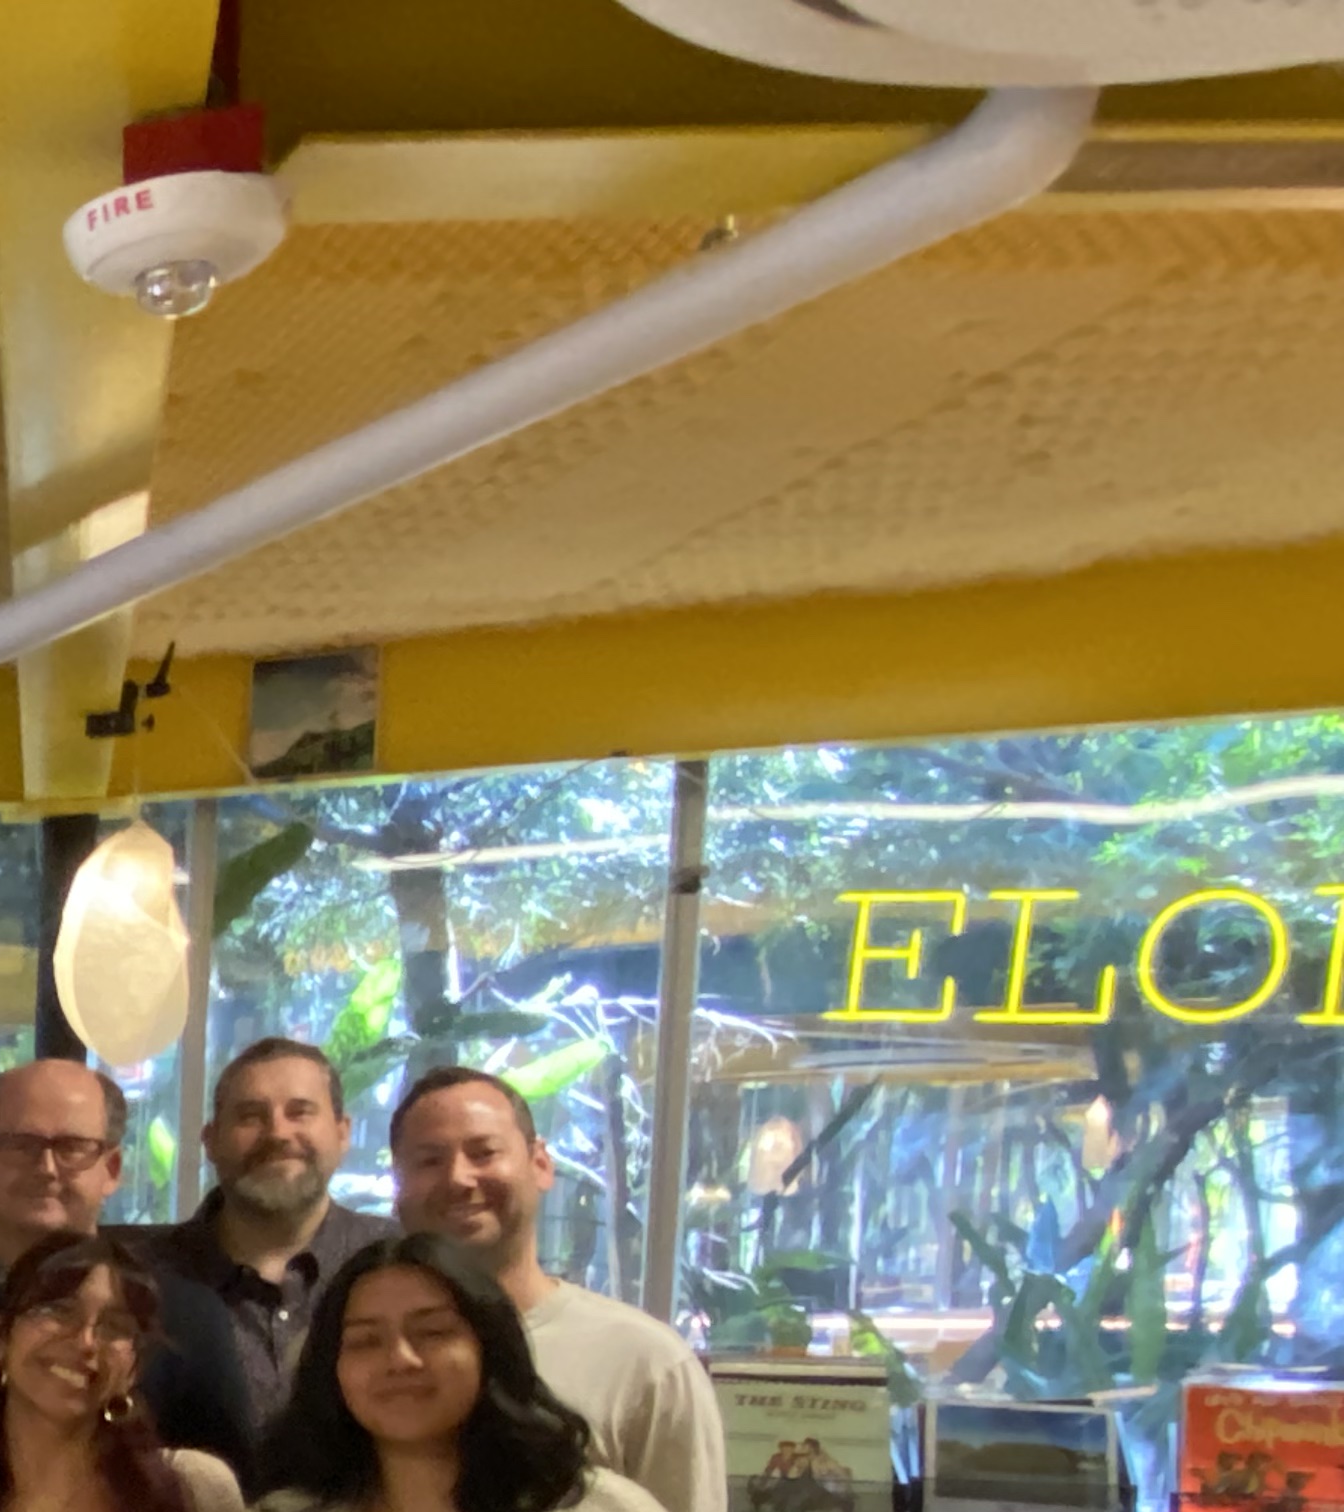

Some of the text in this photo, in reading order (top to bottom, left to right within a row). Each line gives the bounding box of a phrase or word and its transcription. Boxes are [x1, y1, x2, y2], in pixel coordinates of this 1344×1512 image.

[85, 189, 154, 232] FIRE
[734, 1393, 867, 1412] THE STING
